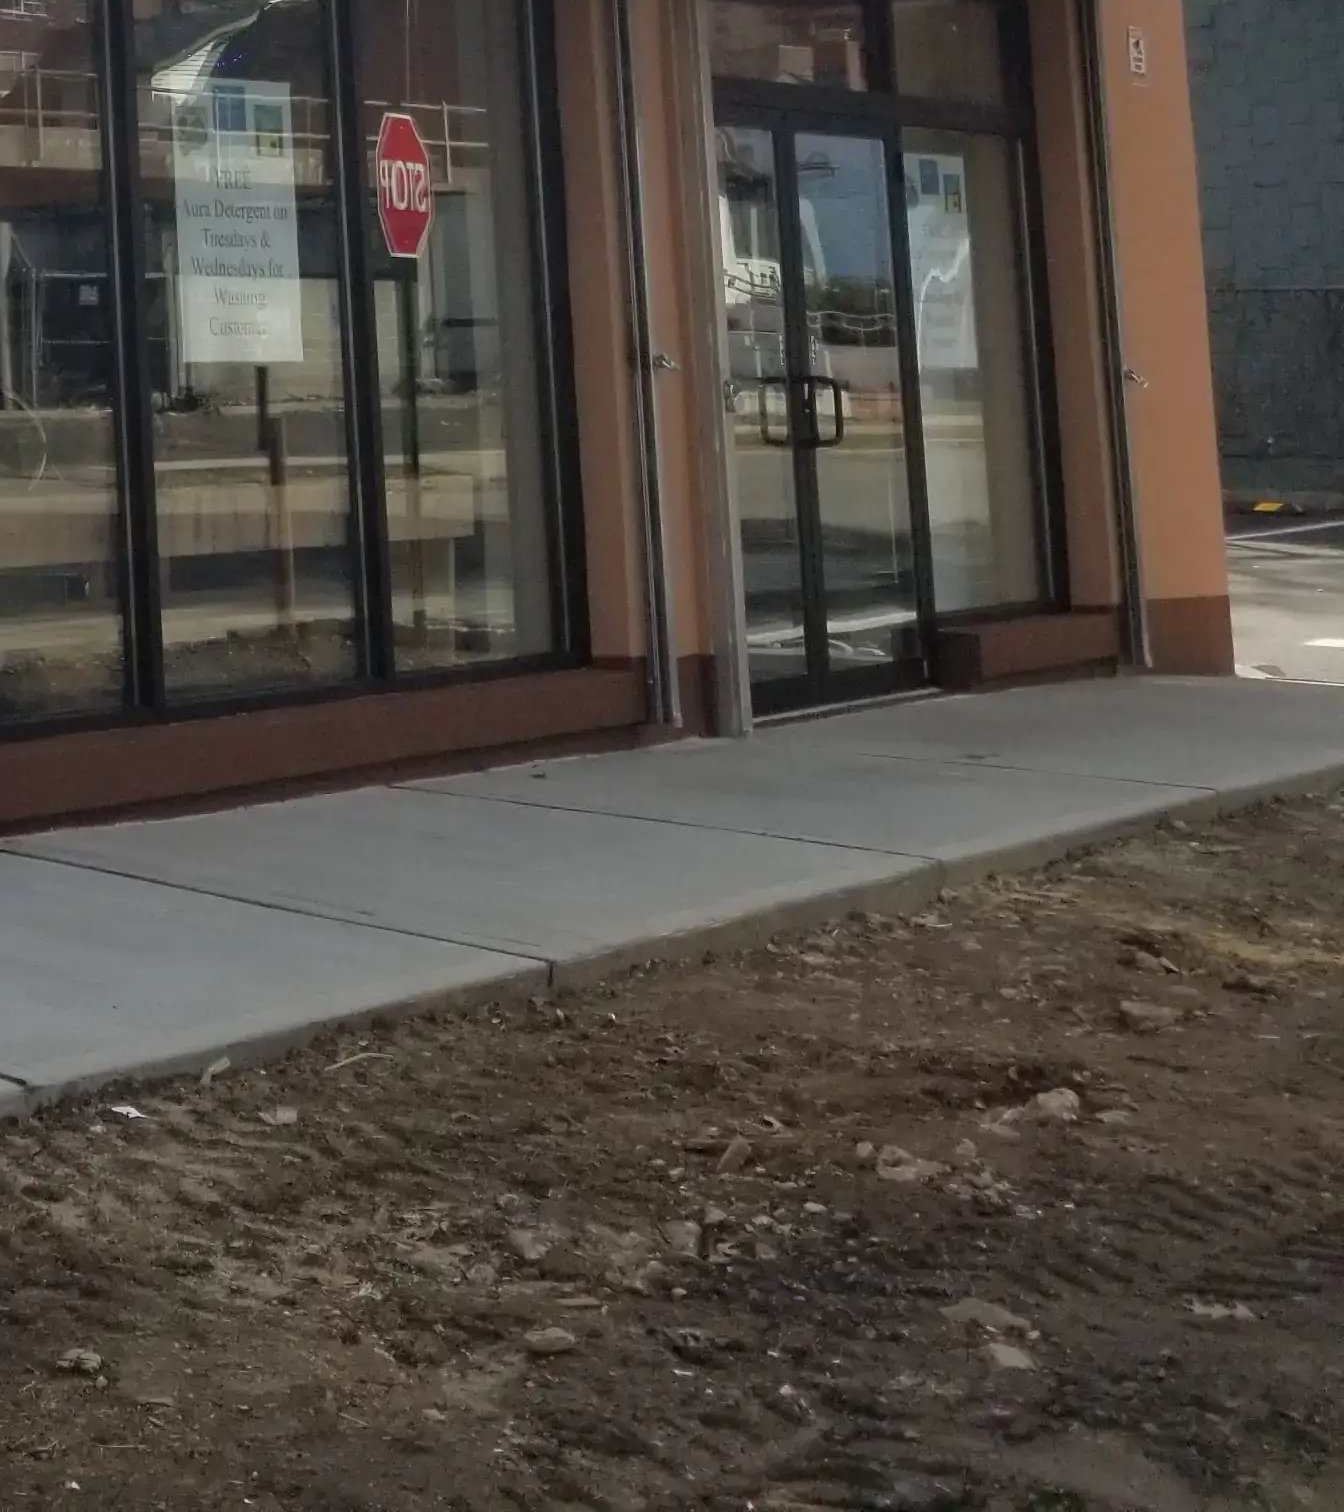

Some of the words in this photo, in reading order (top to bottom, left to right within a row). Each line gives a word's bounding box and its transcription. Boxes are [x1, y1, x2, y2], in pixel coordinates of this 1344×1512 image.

[215, 170, 252, 190] FREE
[214, 199, 270, 223] Detergent
[273, 207, 288, 220] on
[201, 228, 257, 251] Tuesdays
[260, 229, 271, 249] &
[190, 257, 266, 281] Wednesdays
[268, 258, 284, 278] for
